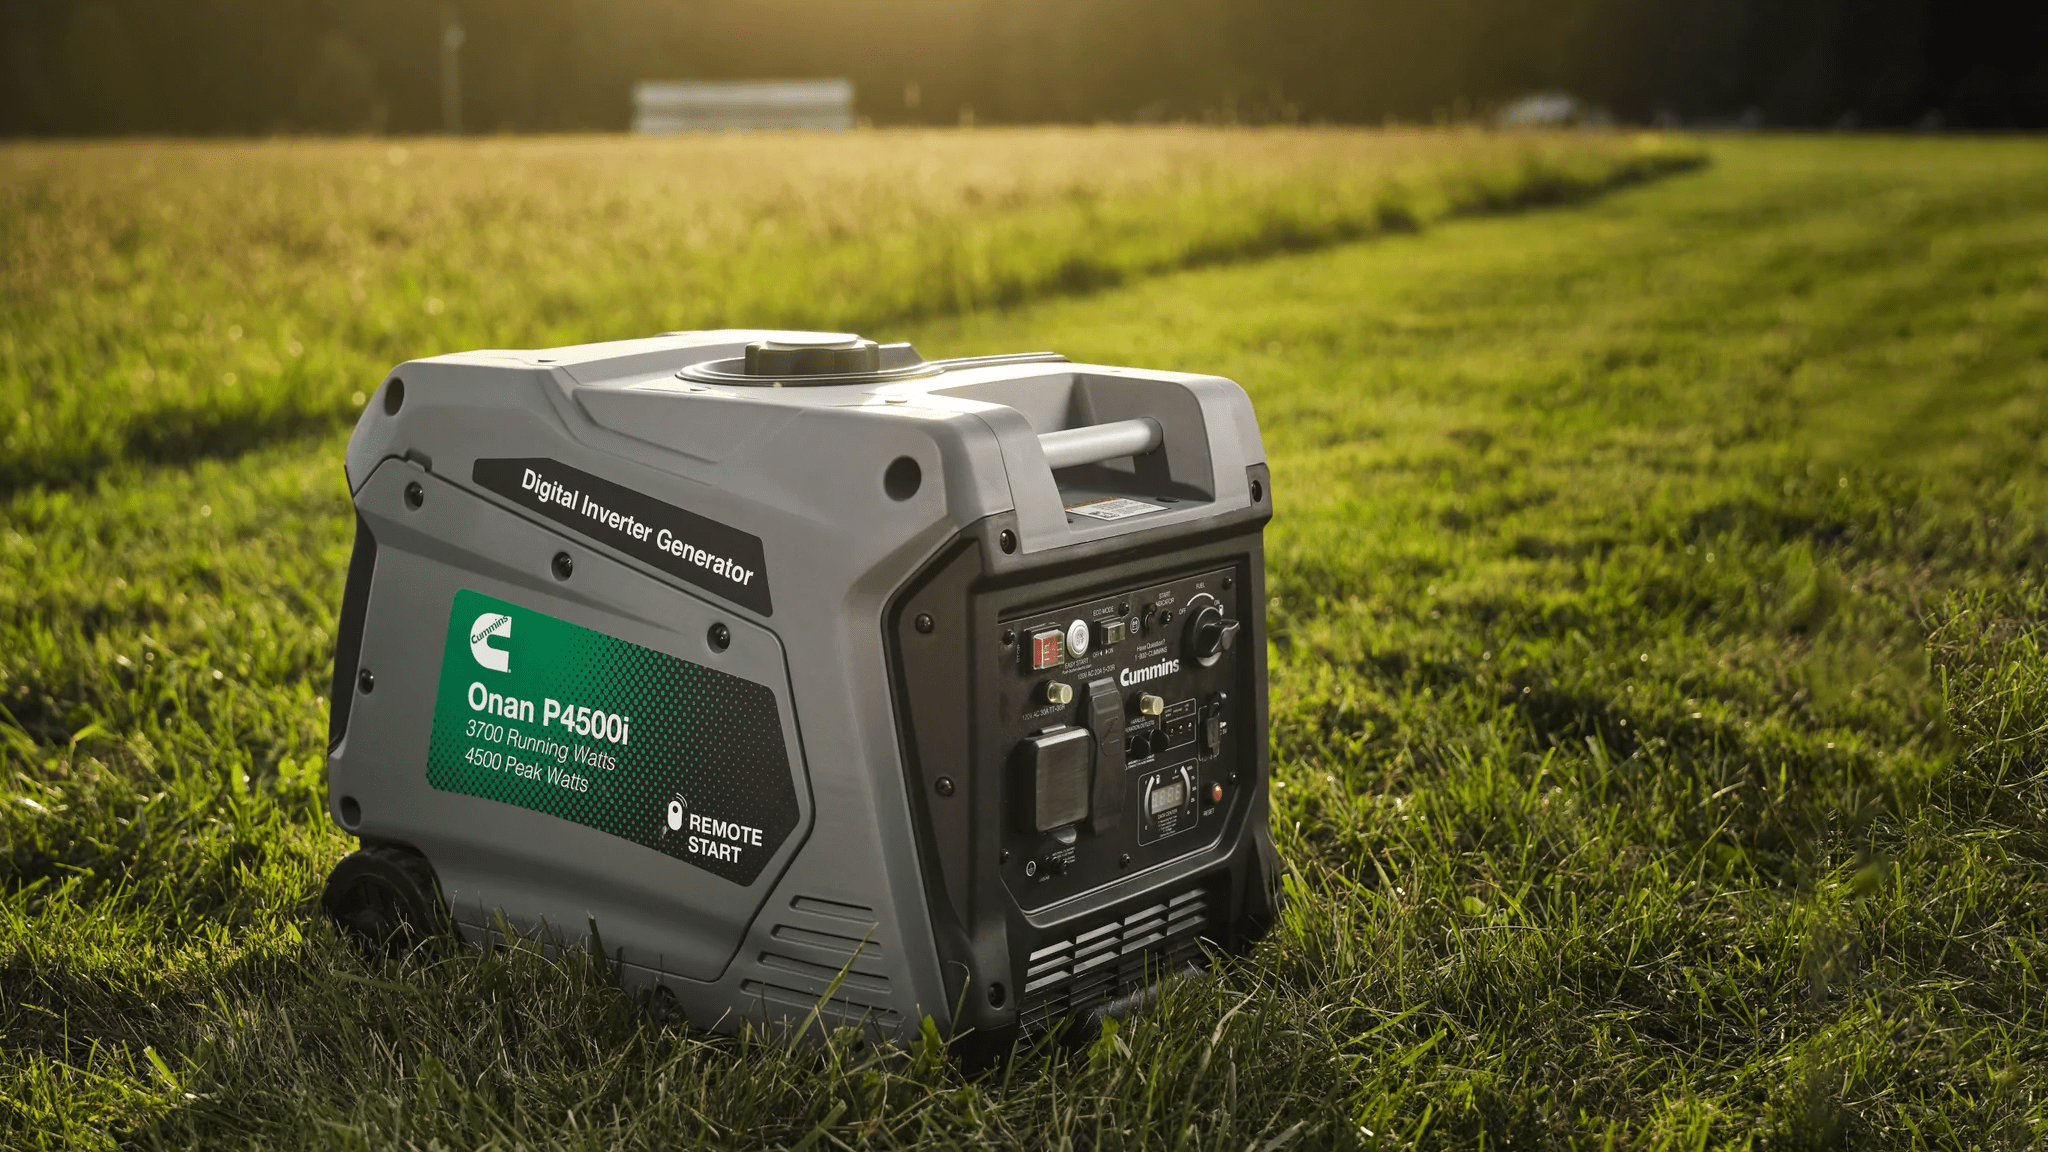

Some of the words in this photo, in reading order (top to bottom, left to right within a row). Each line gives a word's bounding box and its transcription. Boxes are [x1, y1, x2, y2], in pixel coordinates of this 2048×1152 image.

[522, 468, 579, 511] Digital
[581, 495, 653, 542] Inverter
[656, 528, 754, 586] Generator
[1159, 591, 1171, 600] START
[1196, 582, 1205, 590] FUEL
[1102, 606, 1114, 615] MODE
[1179, 607, 1187, 615] OFF
[471, 615, 508, 645] Cummins
[1120, 657, 1180, 687] Cummins
[468, 681, 535, 724] Onan
[543, 698, 629, 745] P4500i
[466, 719, 503, 743] 3700
[506, 728, 569, 764] Running
[574, 744, 616, 771] Watts
[465, 747, 502, 771] 4500
[505, 756, 542, 781] Peak
[547, 766, 589, 793] Watts
[689, 813, 763, 847] REMOTE
[688, 836, 742, 864] START
